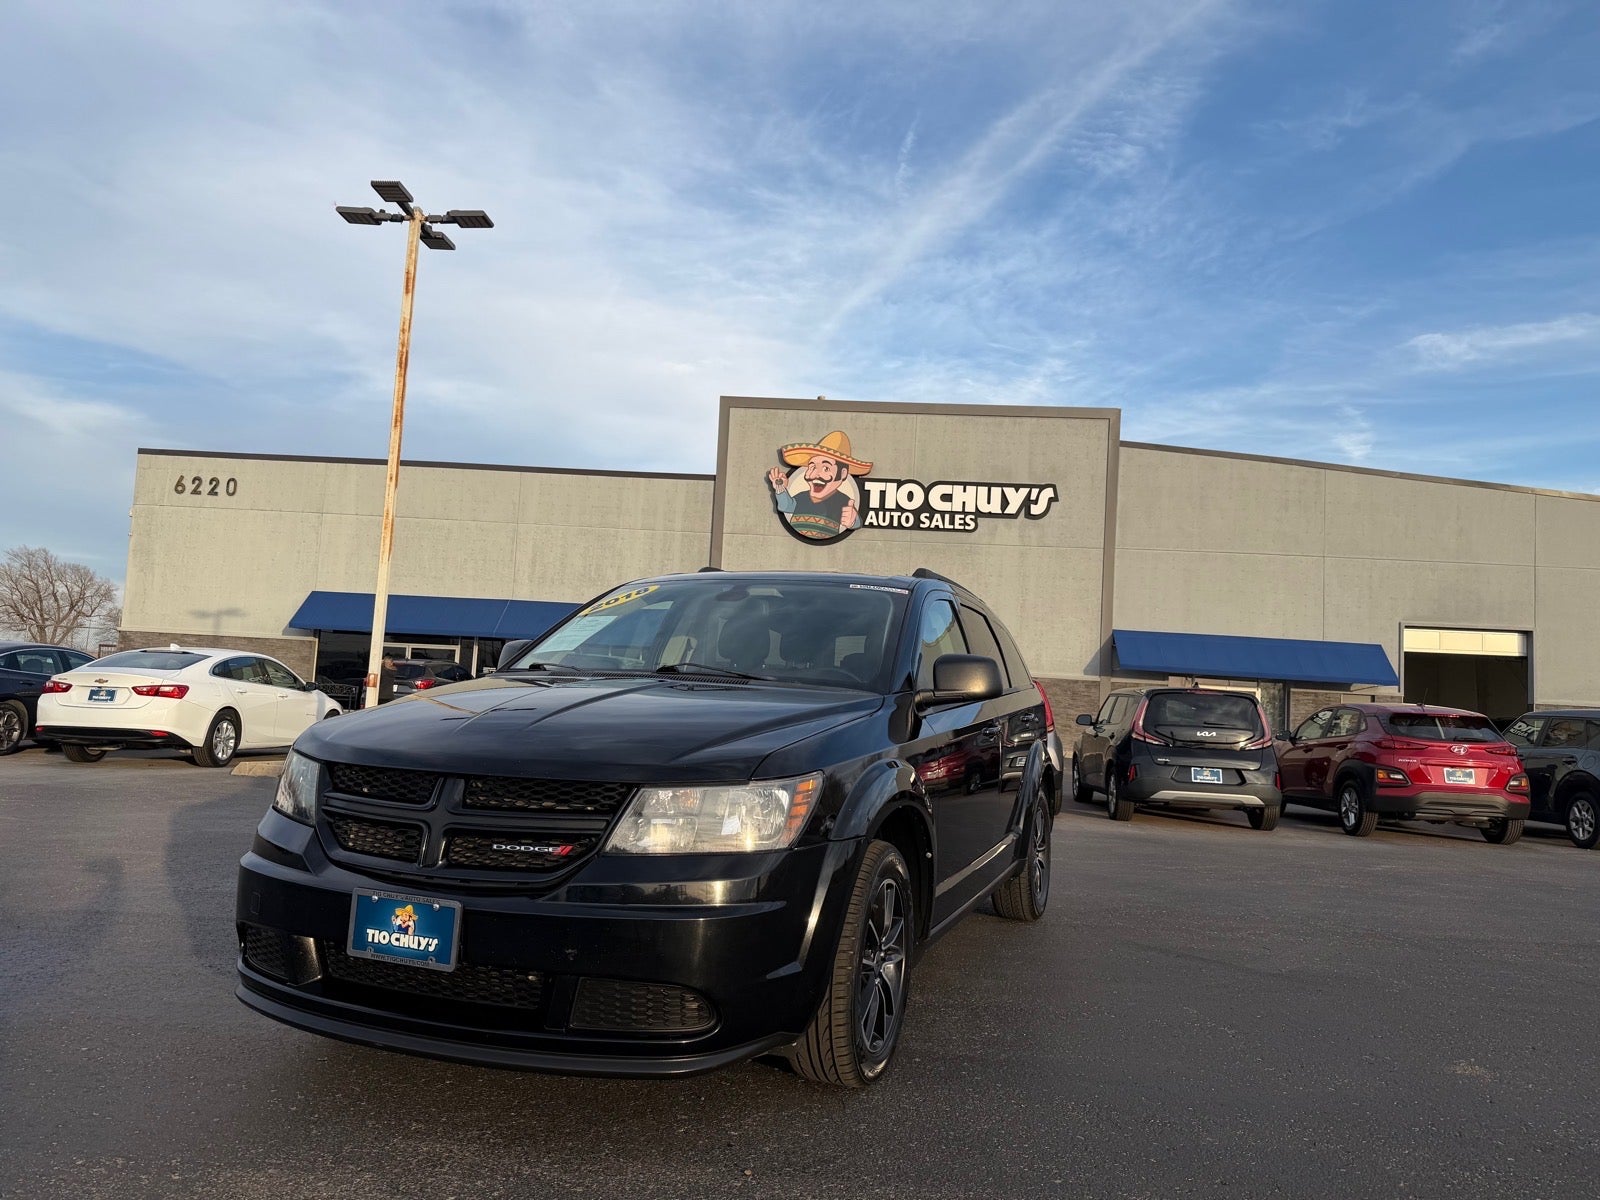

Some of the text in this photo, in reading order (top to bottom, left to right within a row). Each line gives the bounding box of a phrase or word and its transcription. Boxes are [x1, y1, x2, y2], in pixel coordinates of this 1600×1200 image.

[174, 475, 238, 497] 6220
[864, 481, 1055, 516] TIO CHUY'S
[864, 511, 976, 531] AUTO SALES
[492, 843, 562, 853] DODGE
[366, 928, 439, 952] TIO CHUY'S
